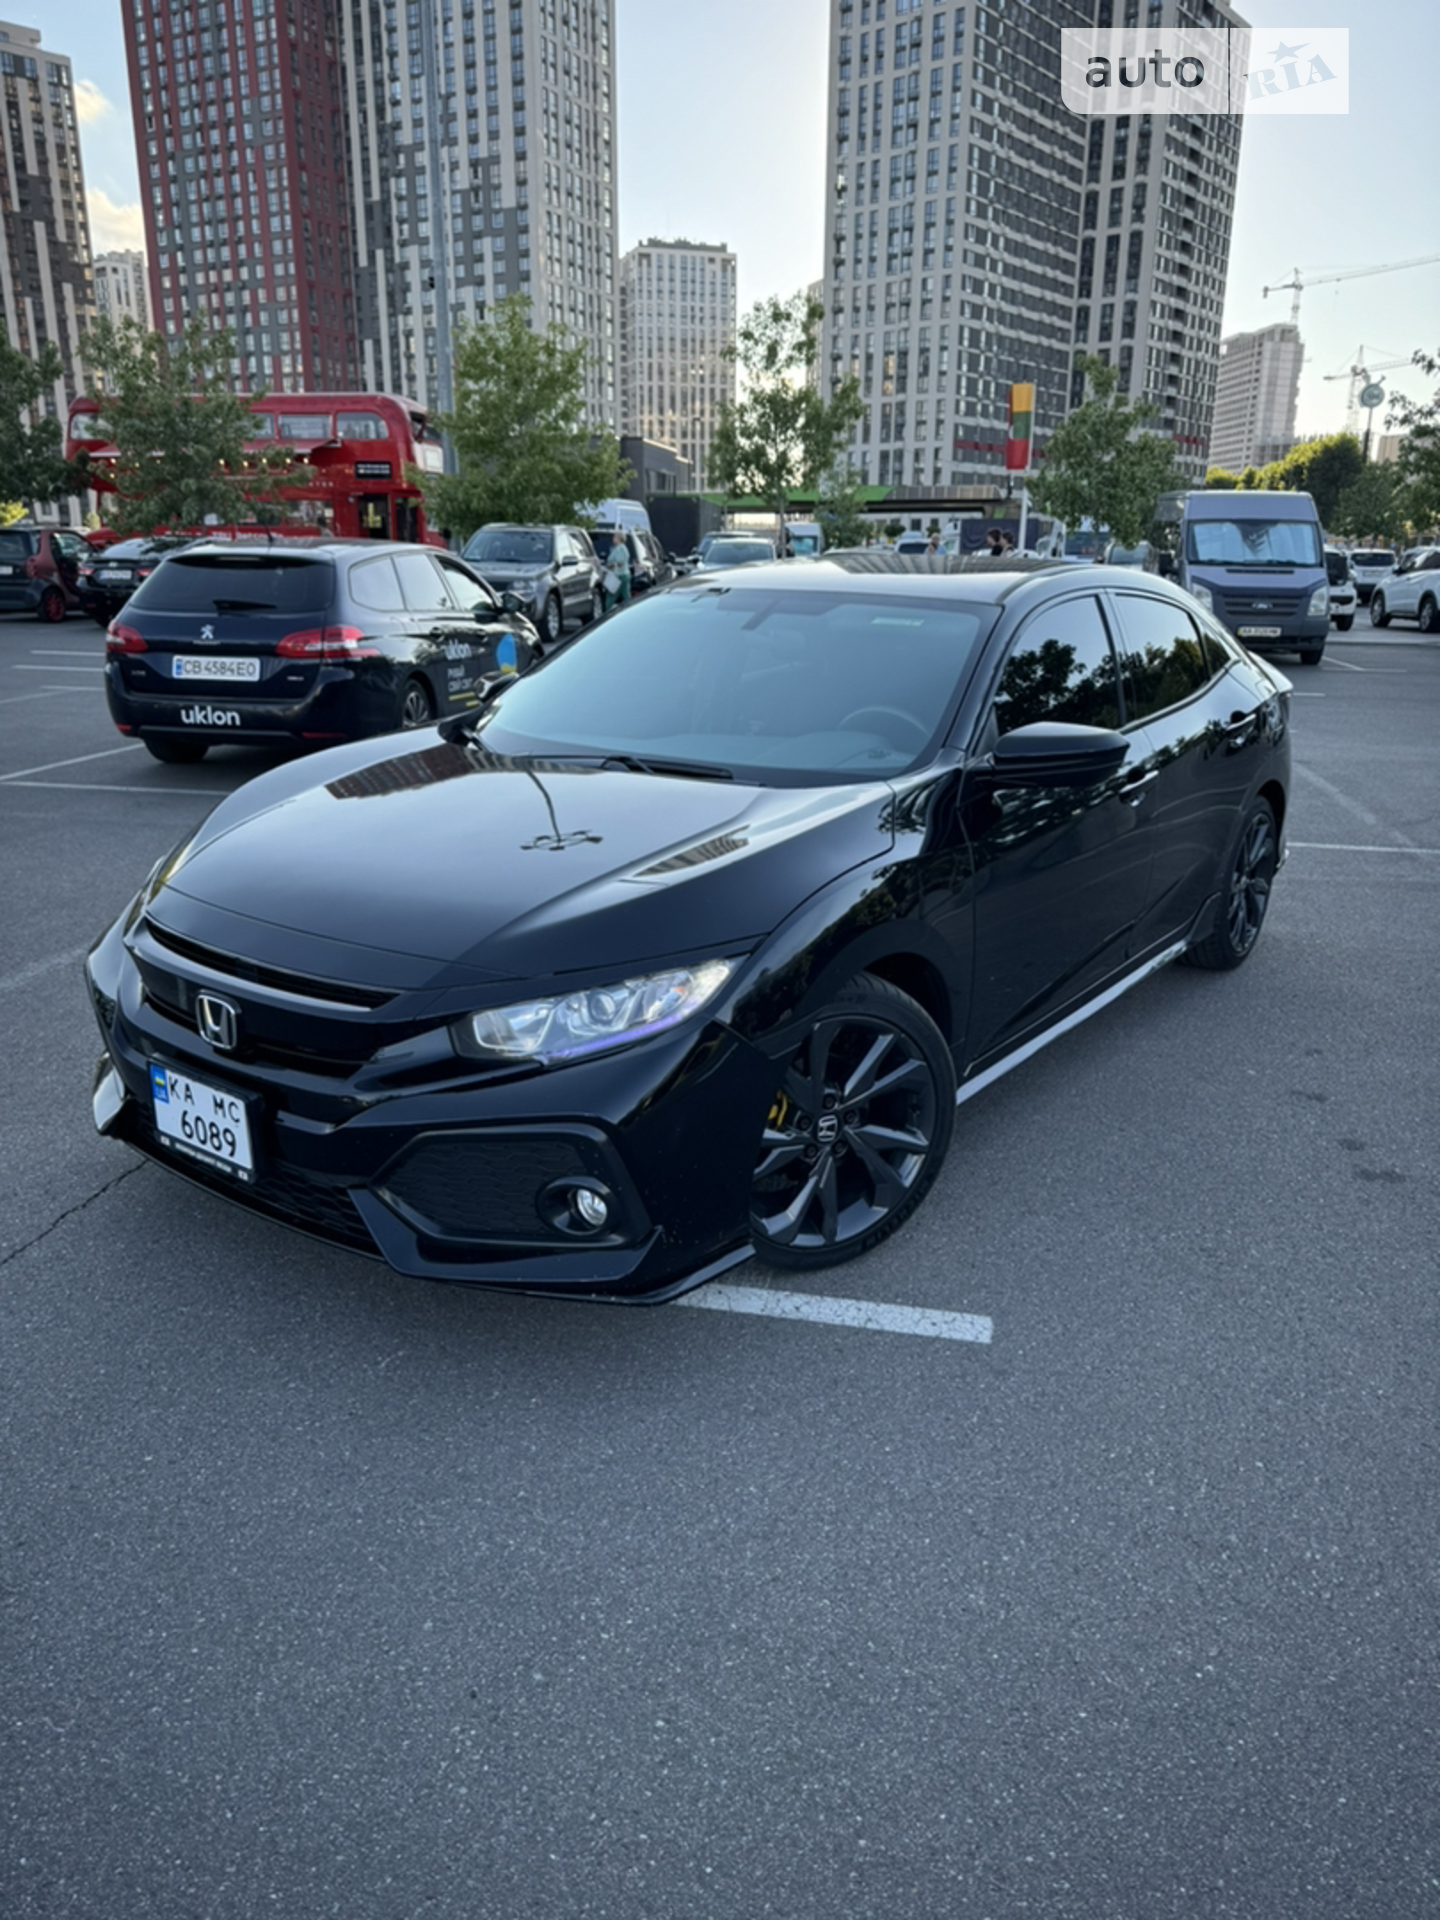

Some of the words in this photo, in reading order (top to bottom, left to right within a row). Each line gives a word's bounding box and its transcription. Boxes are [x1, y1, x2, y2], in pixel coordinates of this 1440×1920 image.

[180, 705, 241, 727] uklon
[169, 1076, 195, 1105] KA
[212, 1095, 240, 1123] MC
[181, 1109, 236, 1157] 6089
